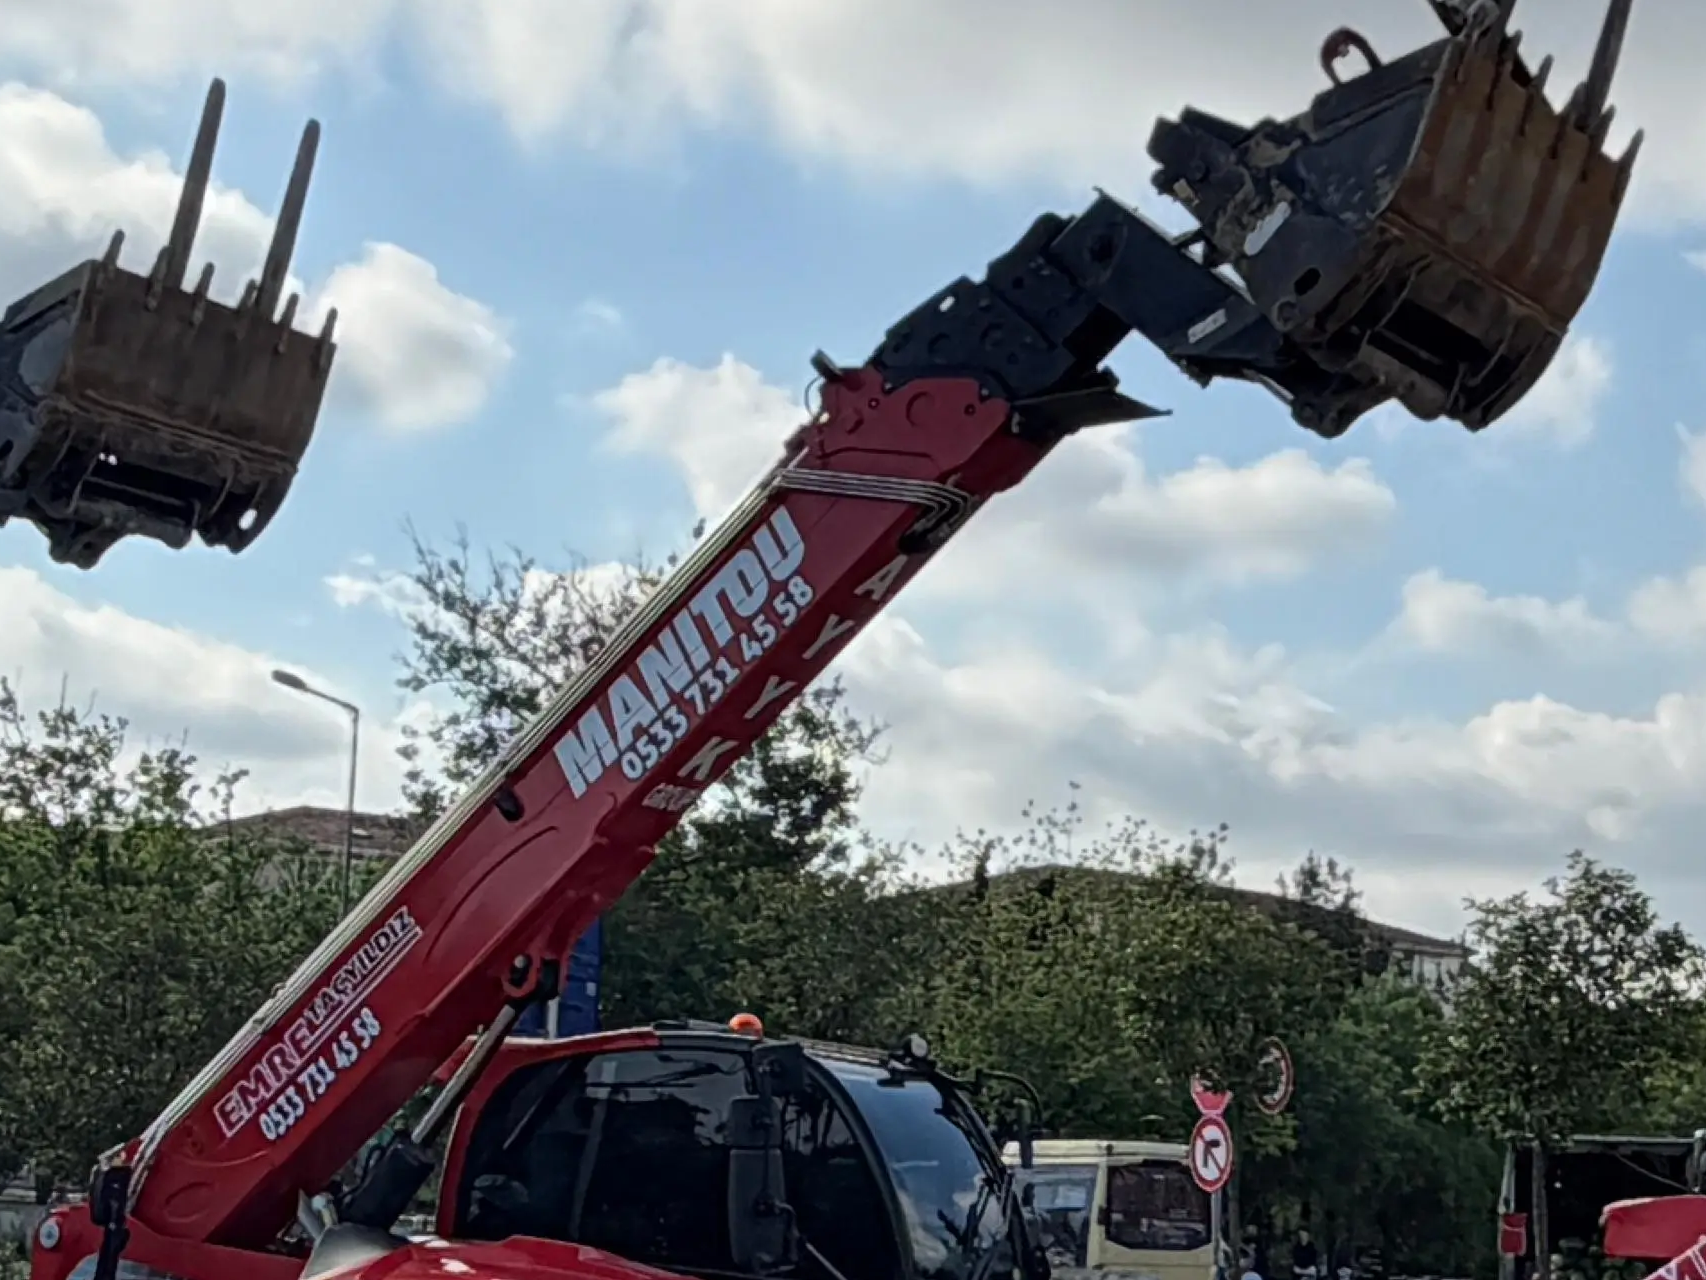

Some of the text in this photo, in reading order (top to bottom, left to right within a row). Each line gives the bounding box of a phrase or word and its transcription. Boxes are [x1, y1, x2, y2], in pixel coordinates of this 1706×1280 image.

[552, 505, 805, 799] MANITOU
[620, 576, 815, 781] 0533 731 45 58
[213, 1017, 312, 1137] EMRE
[259, 1007, 381, 1140] 0533 731 45 58
